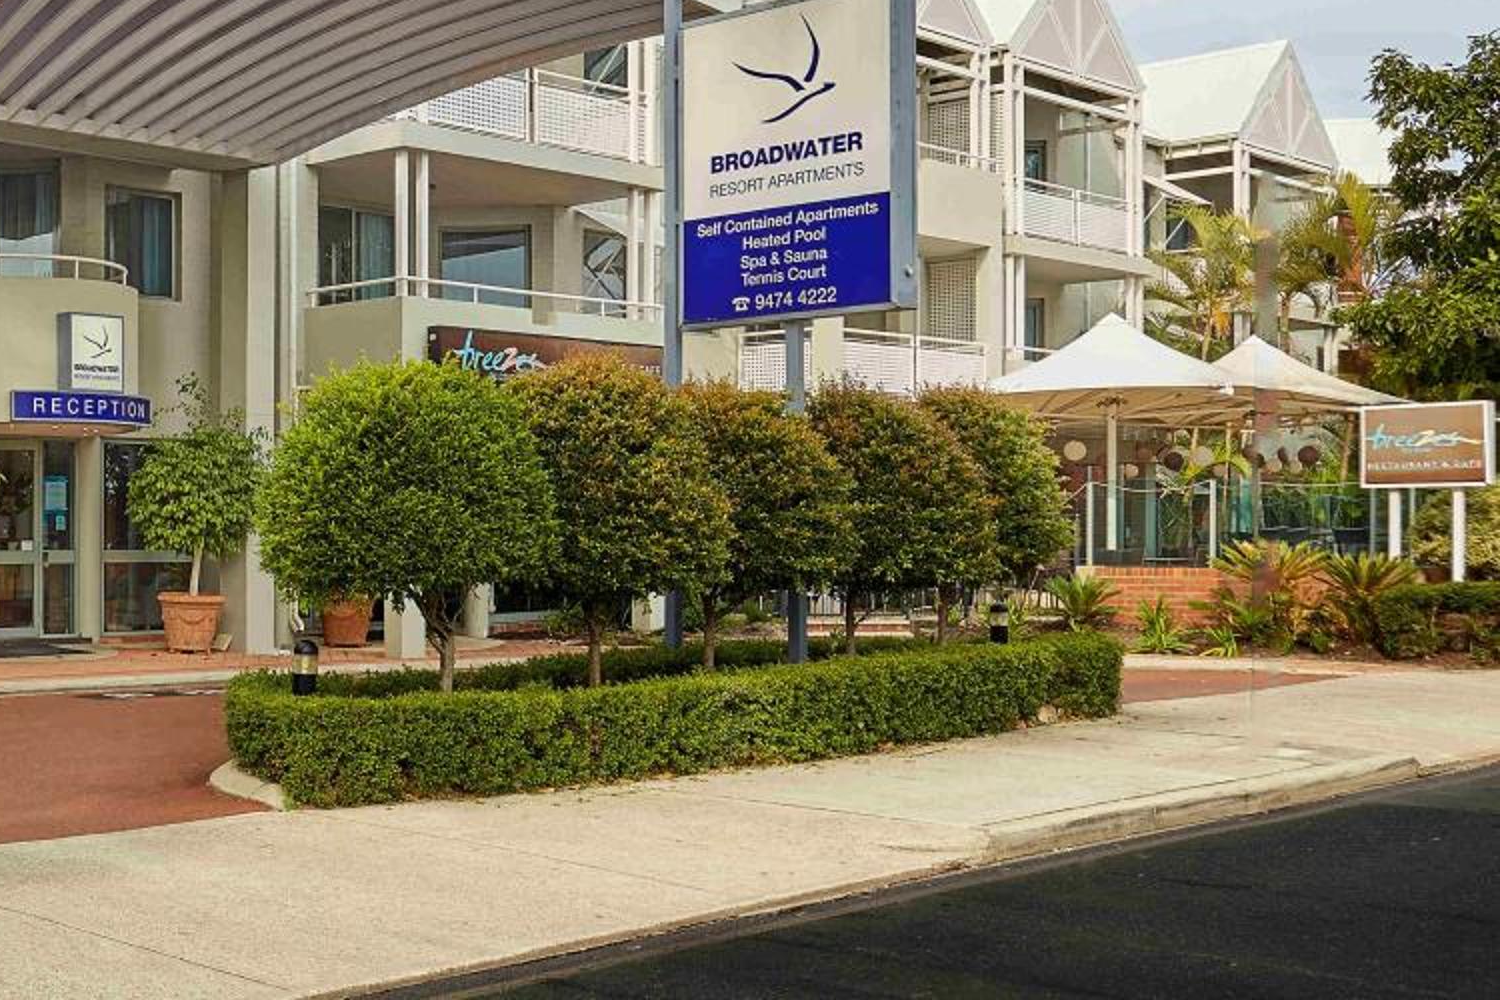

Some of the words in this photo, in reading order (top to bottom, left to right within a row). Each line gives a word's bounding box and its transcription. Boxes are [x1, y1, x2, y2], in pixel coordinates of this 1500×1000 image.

[710, 131, 863, 174] BROADWATER
[709, 177, 764, 198] RESORT
[767, 162, 865, 189] APARTMENTS
[697, 222, 722, 238] Self
[724, 211, 792, 234] Contained
[796, 201, 879, 226] Apartments
[742, 231, 791, 250] Heated
[794, 226, 826, 244] Pool
[740, 254, 767, 270] Spa
[770, 252, 780, 265] &
[783, 247, 828, 264] Sauna
[740, 269, 784, 288] Tennis
[787, 264, 826, 281] Court
[755, 291, 793, 310] 9474
[798, 286, 837, 305] 4222
[32, 397, 145, 419] RECEPTION
